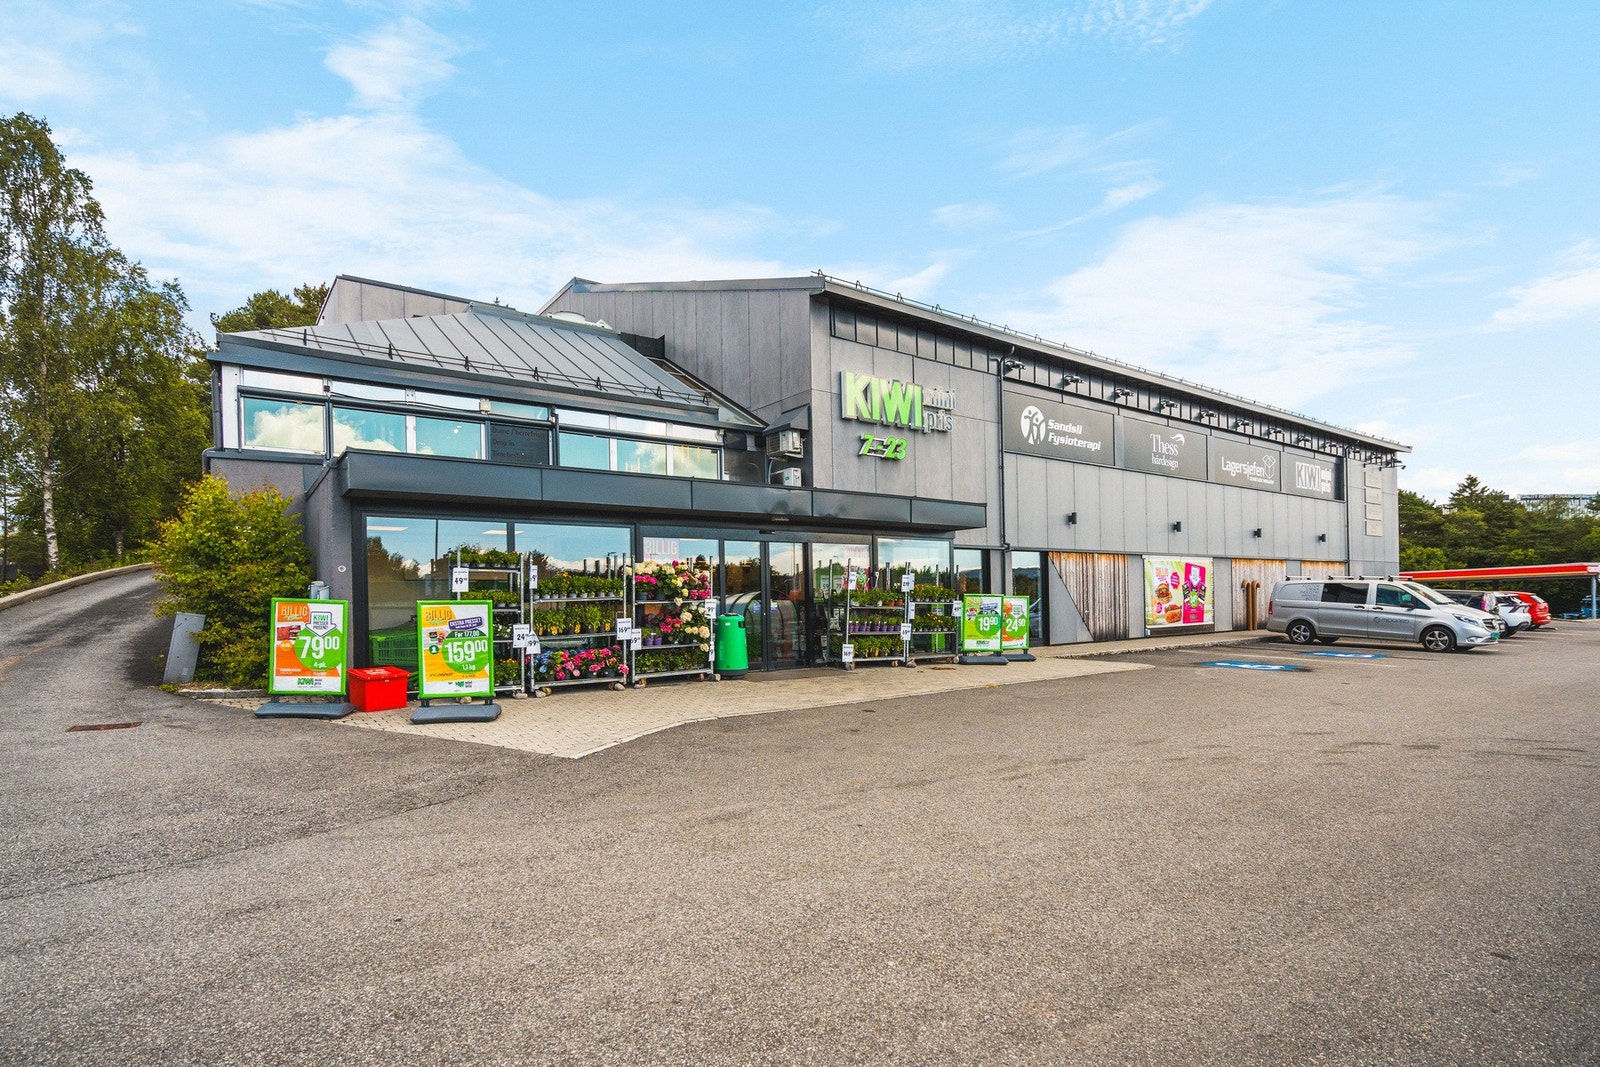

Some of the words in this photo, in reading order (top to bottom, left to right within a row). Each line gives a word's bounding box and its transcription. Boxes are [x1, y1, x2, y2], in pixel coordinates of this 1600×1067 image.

[842, 371, 923, 430] KIWI
[924, 409, 953, 434] pris
[1047, 418, 1083, 435] Sandsli
[1047, 432, 1102, 452] Fysioterapi
[1149, 433, 1179, 457] Thess
[1221, 455, 1265, 480] Lagersjefen
[1295, 461, 1320, 492] KIWI
[645, 540, 678, 555] BILLIG
[281, 605, 308, 617] BILLIG
[425, 609, 453, 621] BILLIG
